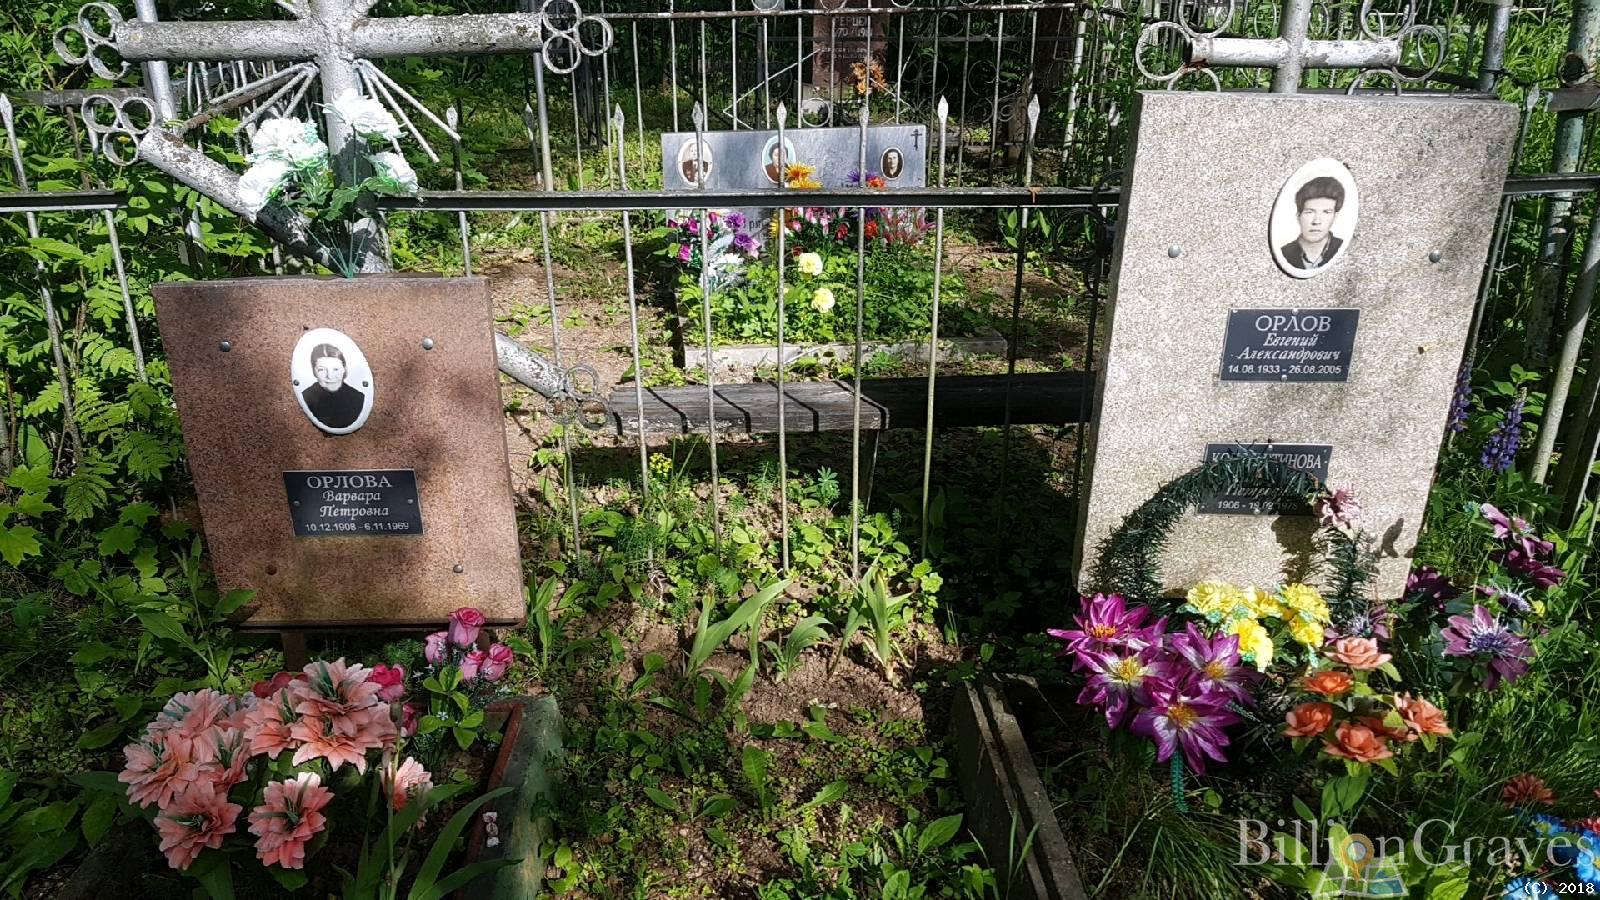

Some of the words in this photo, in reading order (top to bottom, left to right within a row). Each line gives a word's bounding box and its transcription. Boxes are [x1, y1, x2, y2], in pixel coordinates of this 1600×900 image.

[1255, 315, 1332, 332] ОРЛОВ
[1263, 332, 1319, 346] Евгений
[1237, 346, 1341, 363] Александрович
[1228, 365, 1280, 374] 14.08.1933
[1288, 365, 1341, 374] 26.08.2005
[1212, 452, 1321, 469] КОТИНОВА
[306, 475, 392, 488] ОРЛОВА
[322, 490, 381, 504] Варвара
[319, 504, 389, 520] Петровна
[1217, 501, 1240, 509] 1906
[305, 522, 356, 531] 10.12.1908
[364, 522, 409, 530] 6.11.1969
